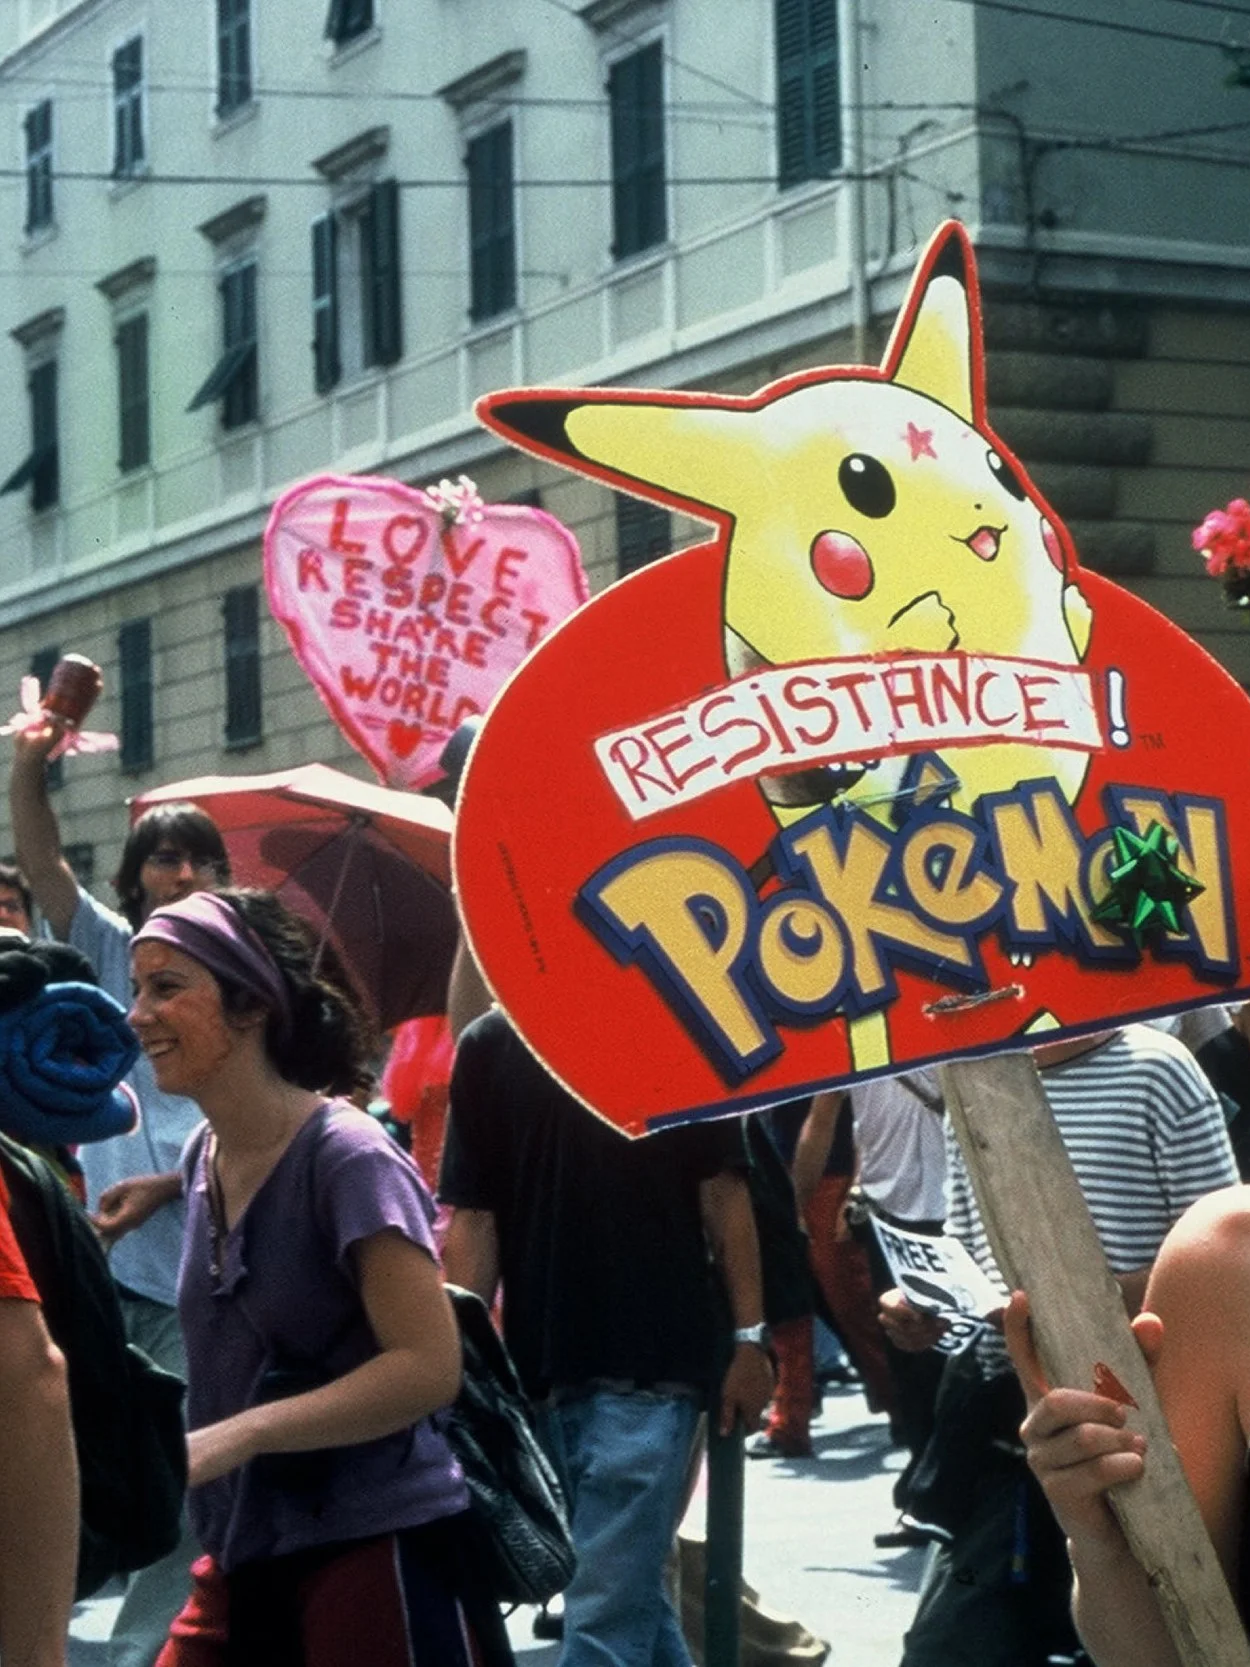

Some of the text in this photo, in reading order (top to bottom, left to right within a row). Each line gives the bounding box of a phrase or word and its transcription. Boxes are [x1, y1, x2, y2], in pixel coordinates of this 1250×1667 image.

[329, 499, 528, 598] LOVE
[297, 548, 550, 650] RESPECT
[370, 641, 451, 689] THE
